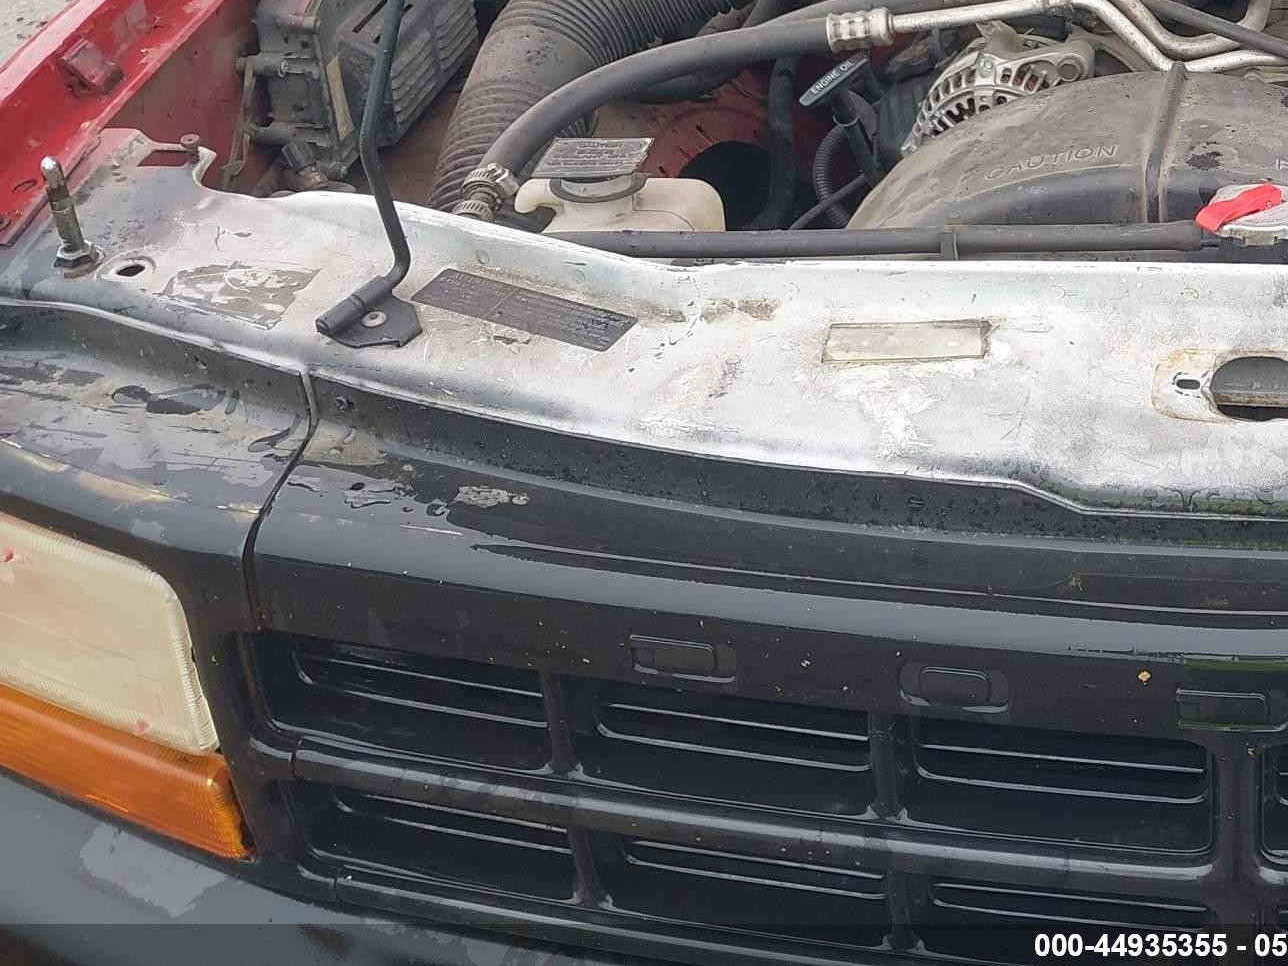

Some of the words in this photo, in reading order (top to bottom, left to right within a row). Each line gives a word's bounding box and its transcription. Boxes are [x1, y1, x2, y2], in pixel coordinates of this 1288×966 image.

[811, 70, 841, 95] ENGINE
[839, 60, 855, 72] OIL
[984, 145, 1118, 181] CAUTION
